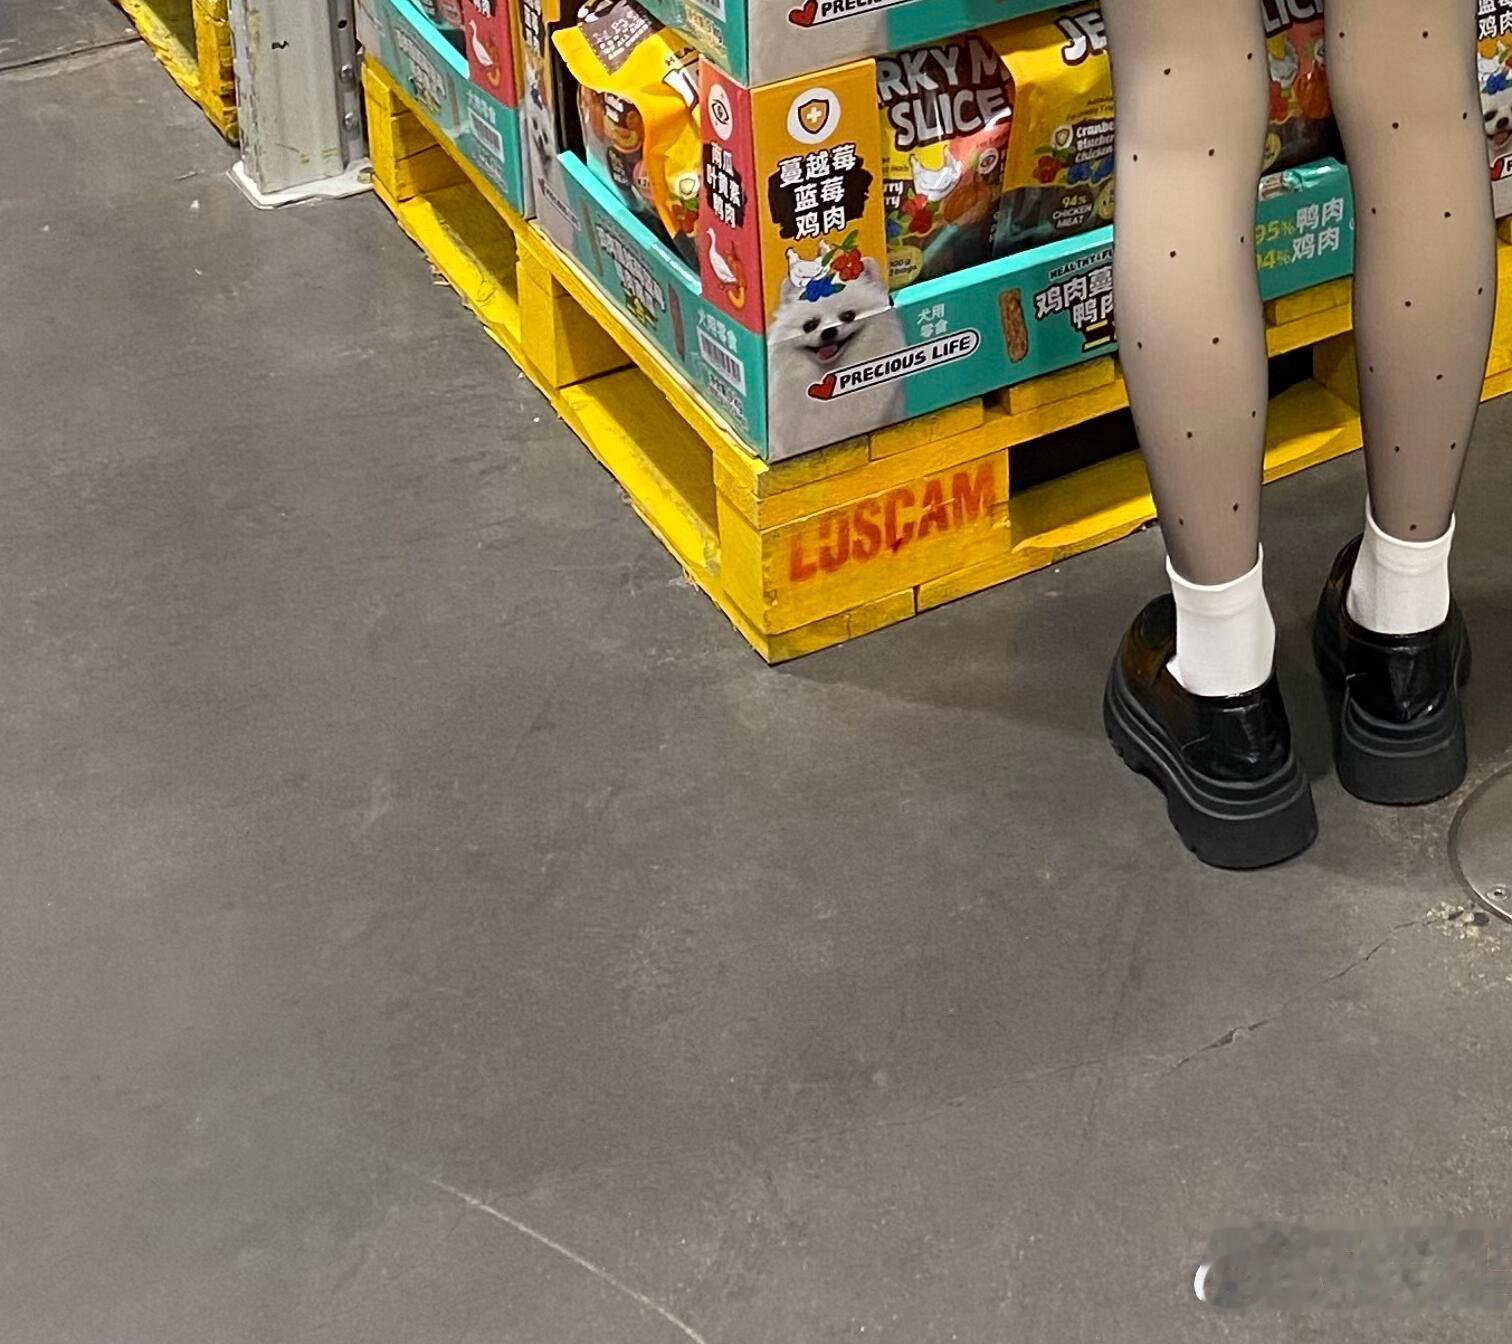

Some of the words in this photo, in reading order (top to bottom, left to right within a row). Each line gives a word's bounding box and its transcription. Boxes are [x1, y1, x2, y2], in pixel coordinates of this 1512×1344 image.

[892, 86, 1012, 152] SLICE
[777, 143, 857, 191] 蔓越莓
[793, 178, 846, 212] 蓝莓
[1295, 197, 1345, 233] 鸭肉
[795, 206, 847, 242] 鸡肉
[1290, 224, 1340, 263] 鸡肉
[840, 347, 928, 390] PRECIOUS
[933, 333, 972, 364] LIFE
[787, 459, 998, 585] LOSCAM
